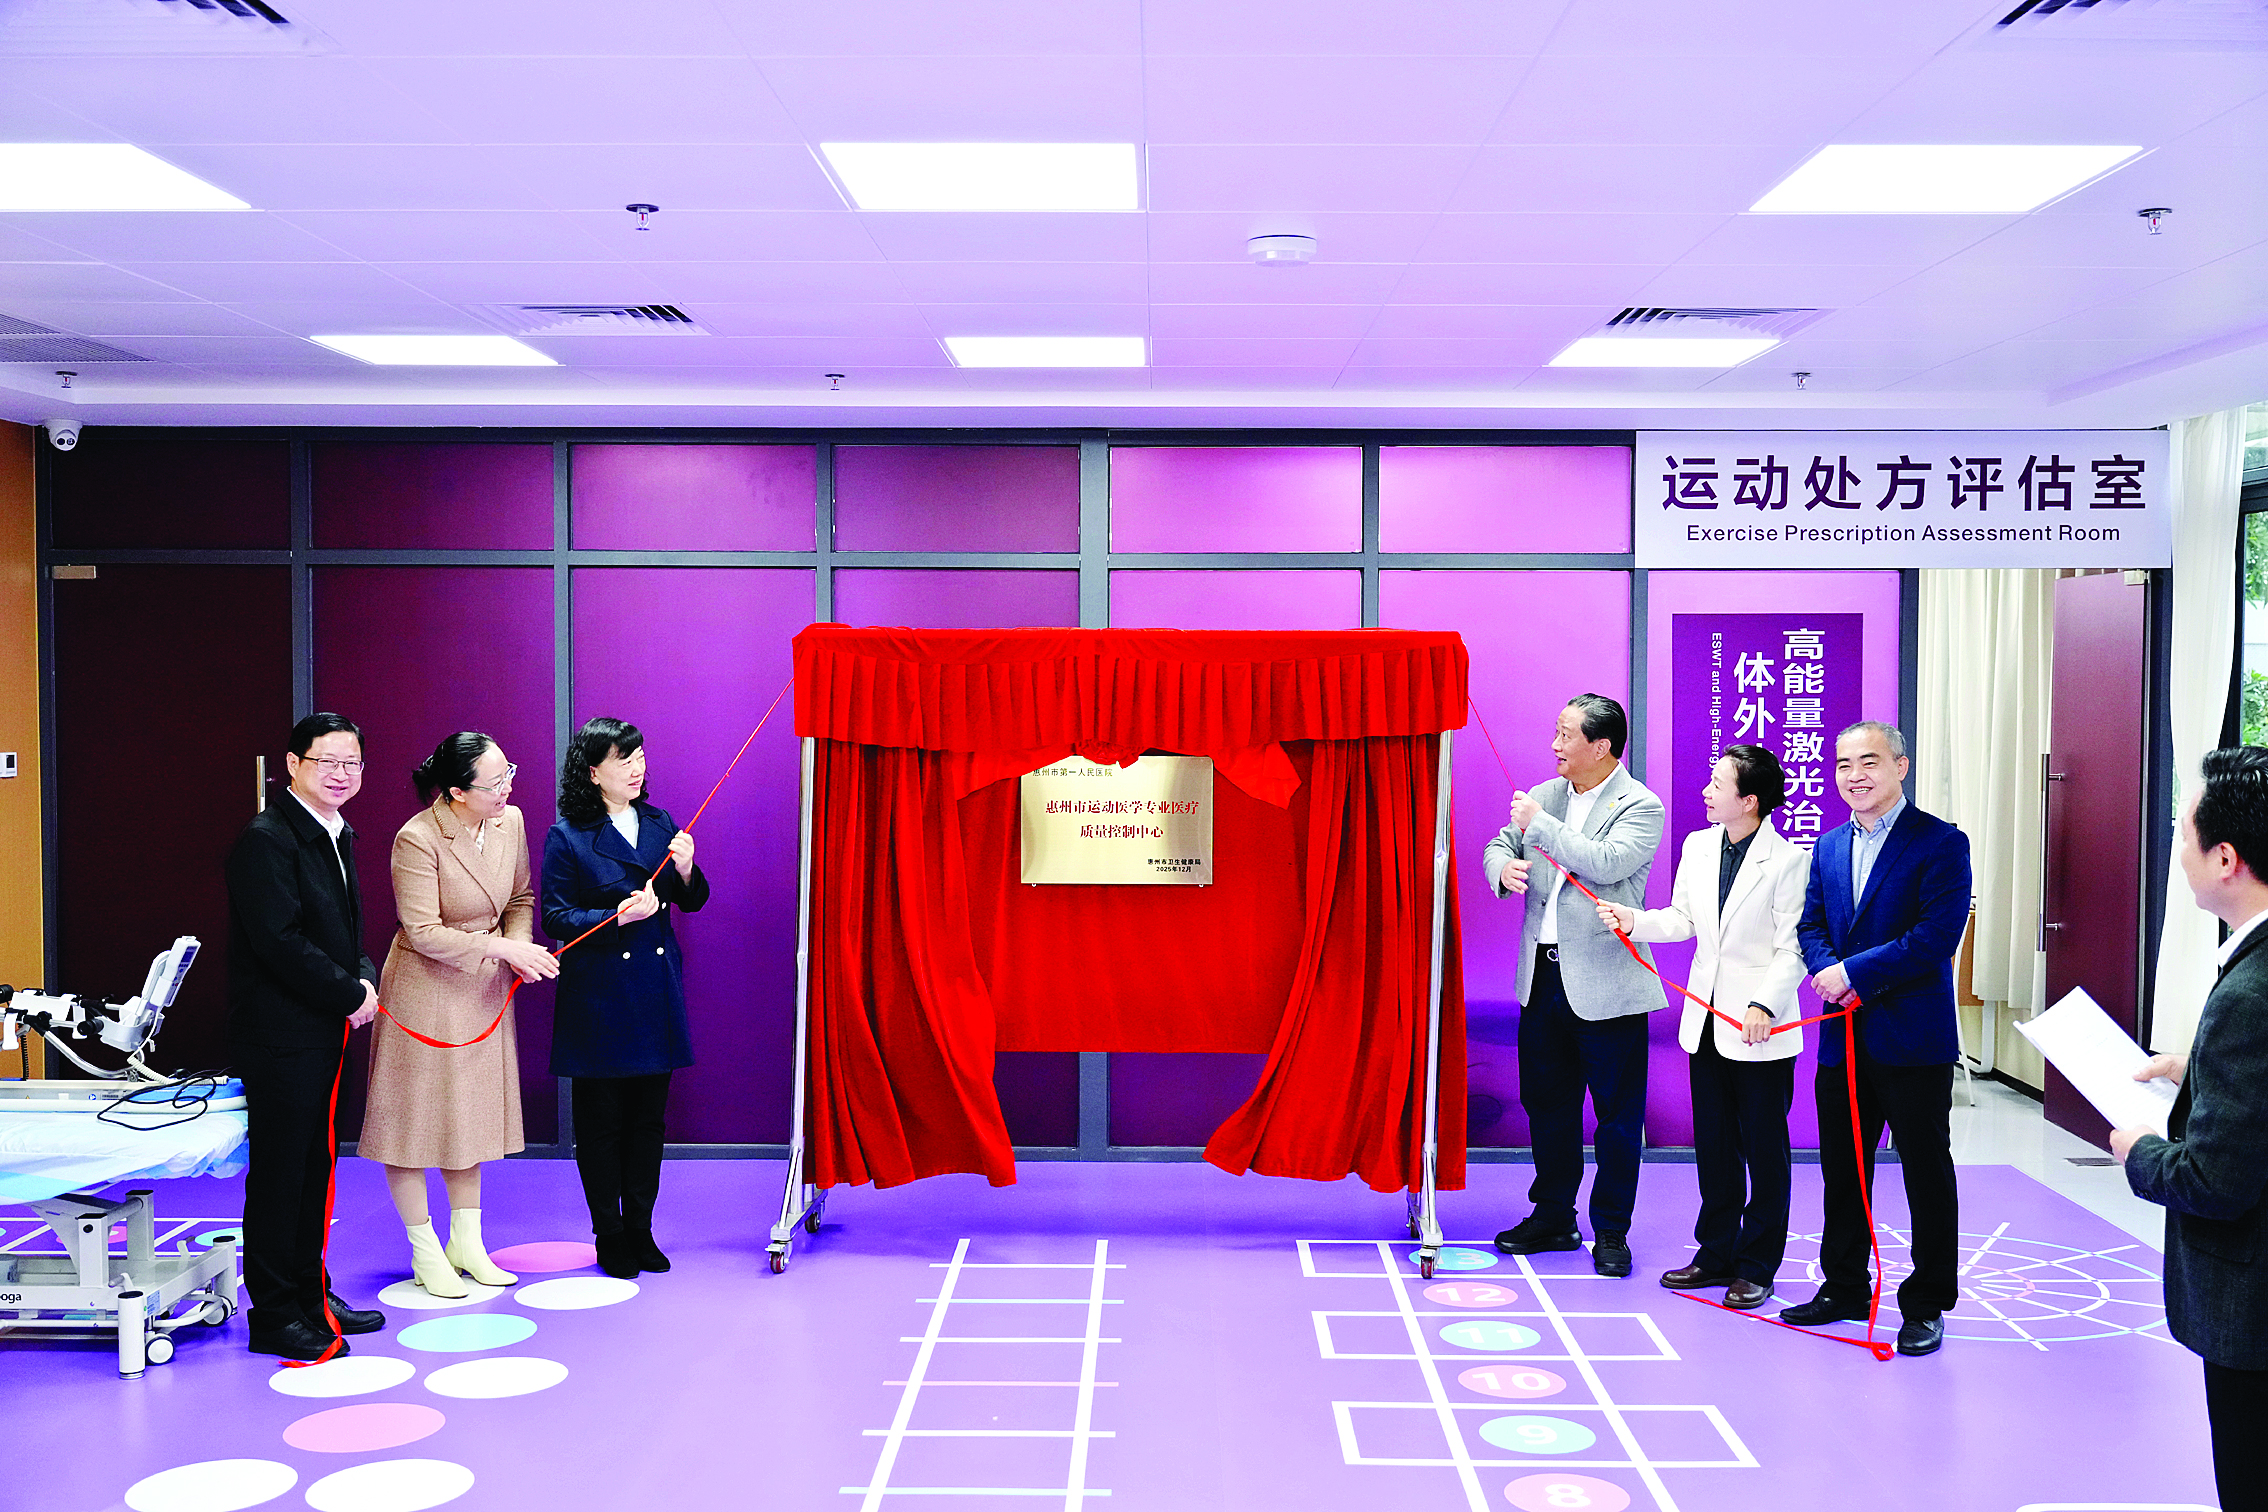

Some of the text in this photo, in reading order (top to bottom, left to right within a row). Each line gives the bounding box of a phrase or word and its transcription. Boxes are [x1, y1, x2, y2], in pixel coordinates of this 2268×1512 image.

[1662, 454, 2147, 511] 运动处方评估室
[1687, 525, 2120, 545] Exercise Prescription Assessment Room
[1711, 632, 1722, 668] ESWT
[1711, 670, 1721, 693] and
[1732, 651, 1776, 747] 体外
[1045, 800, 1200, 815] 惠州市运动医学专业医疗
[1080, 824, 1164, 839] 质量控制中心
[0, 1293, 22, 1304] oga
[1436, 1287, 1506, 1302] 12
[1458, 1327, 1525, 1344] 11
[1471, 1372, 1551, 1392] 10
[1516, 1425, 1558, 1445] 9
[1544, 1483, 1592, 1507] 8
